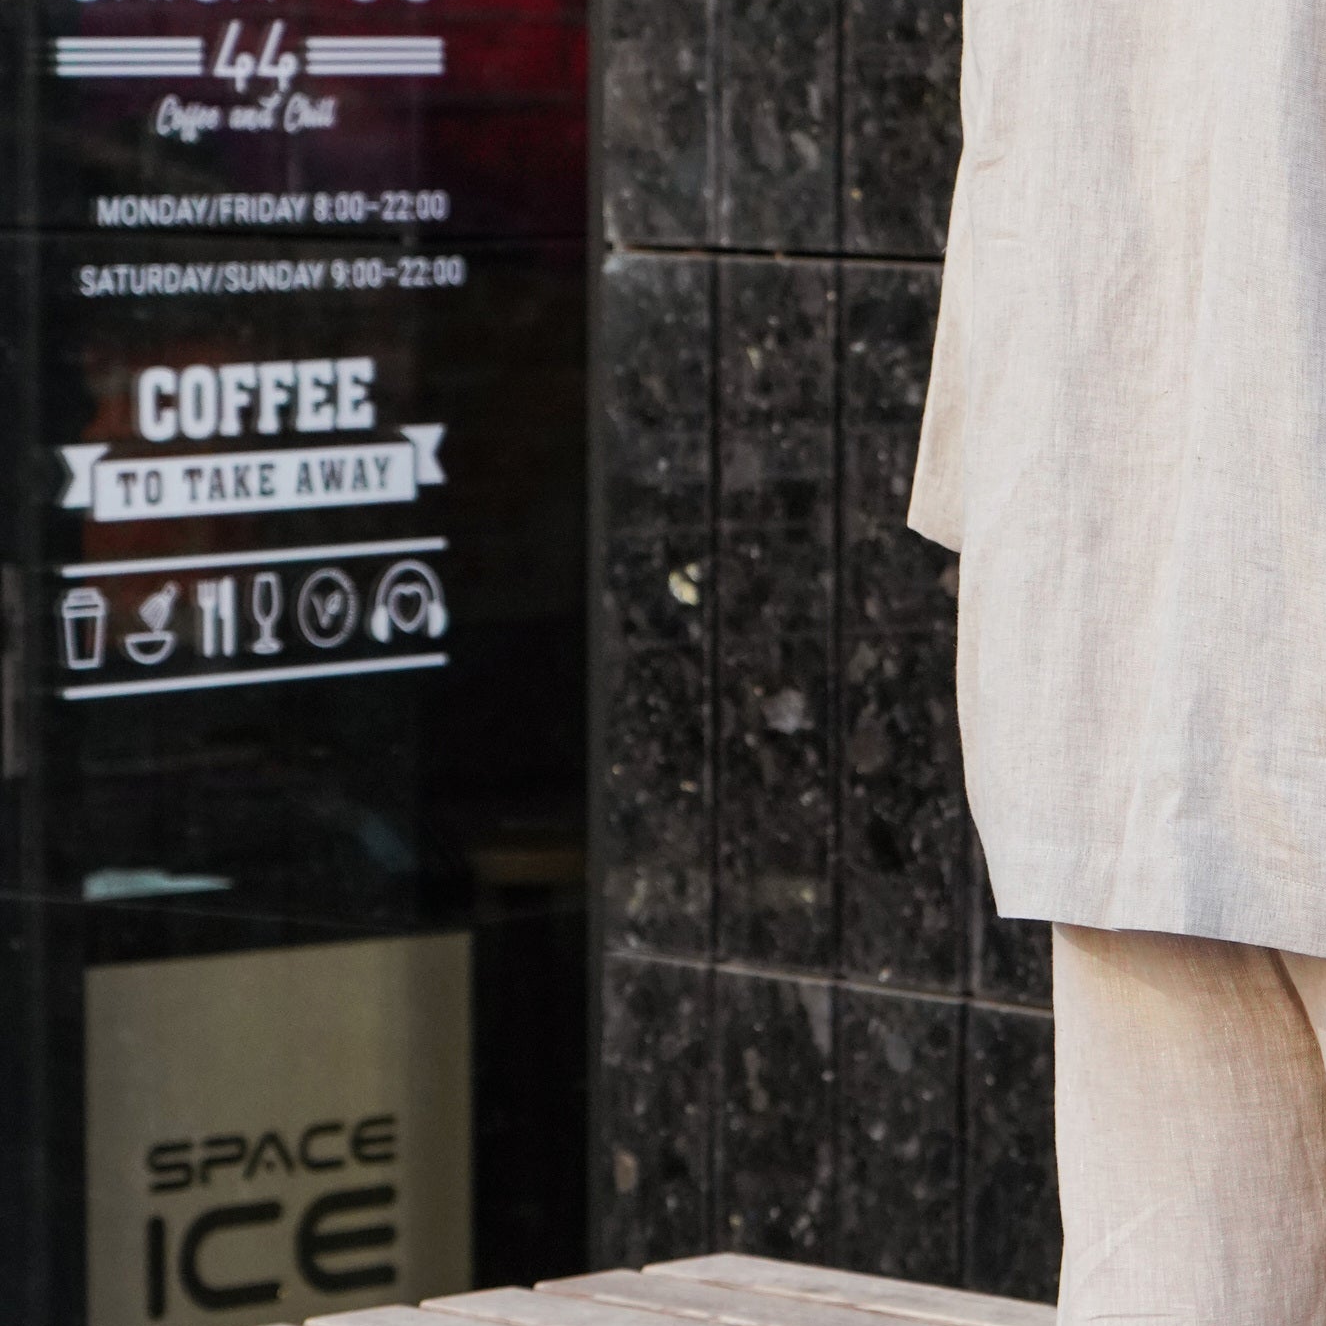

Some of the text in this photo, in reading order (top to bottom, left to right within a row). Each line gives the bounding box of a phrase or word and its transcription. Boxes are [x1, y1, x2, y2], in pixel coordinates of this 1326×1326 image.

[212, 19, 299, 93] 44
[96, 193, 307, 227] MONDAY/FRIDAY
[79, 261, 326, 297] SATURDAY/SUNDAY
[138, 357, 375, 441] COFFEE
[116, 455, 392, 506] TO TAKE AWAY
[147, 1113, 396, 1193] SPACE
[147, 1184, 397, 1320] ICE
